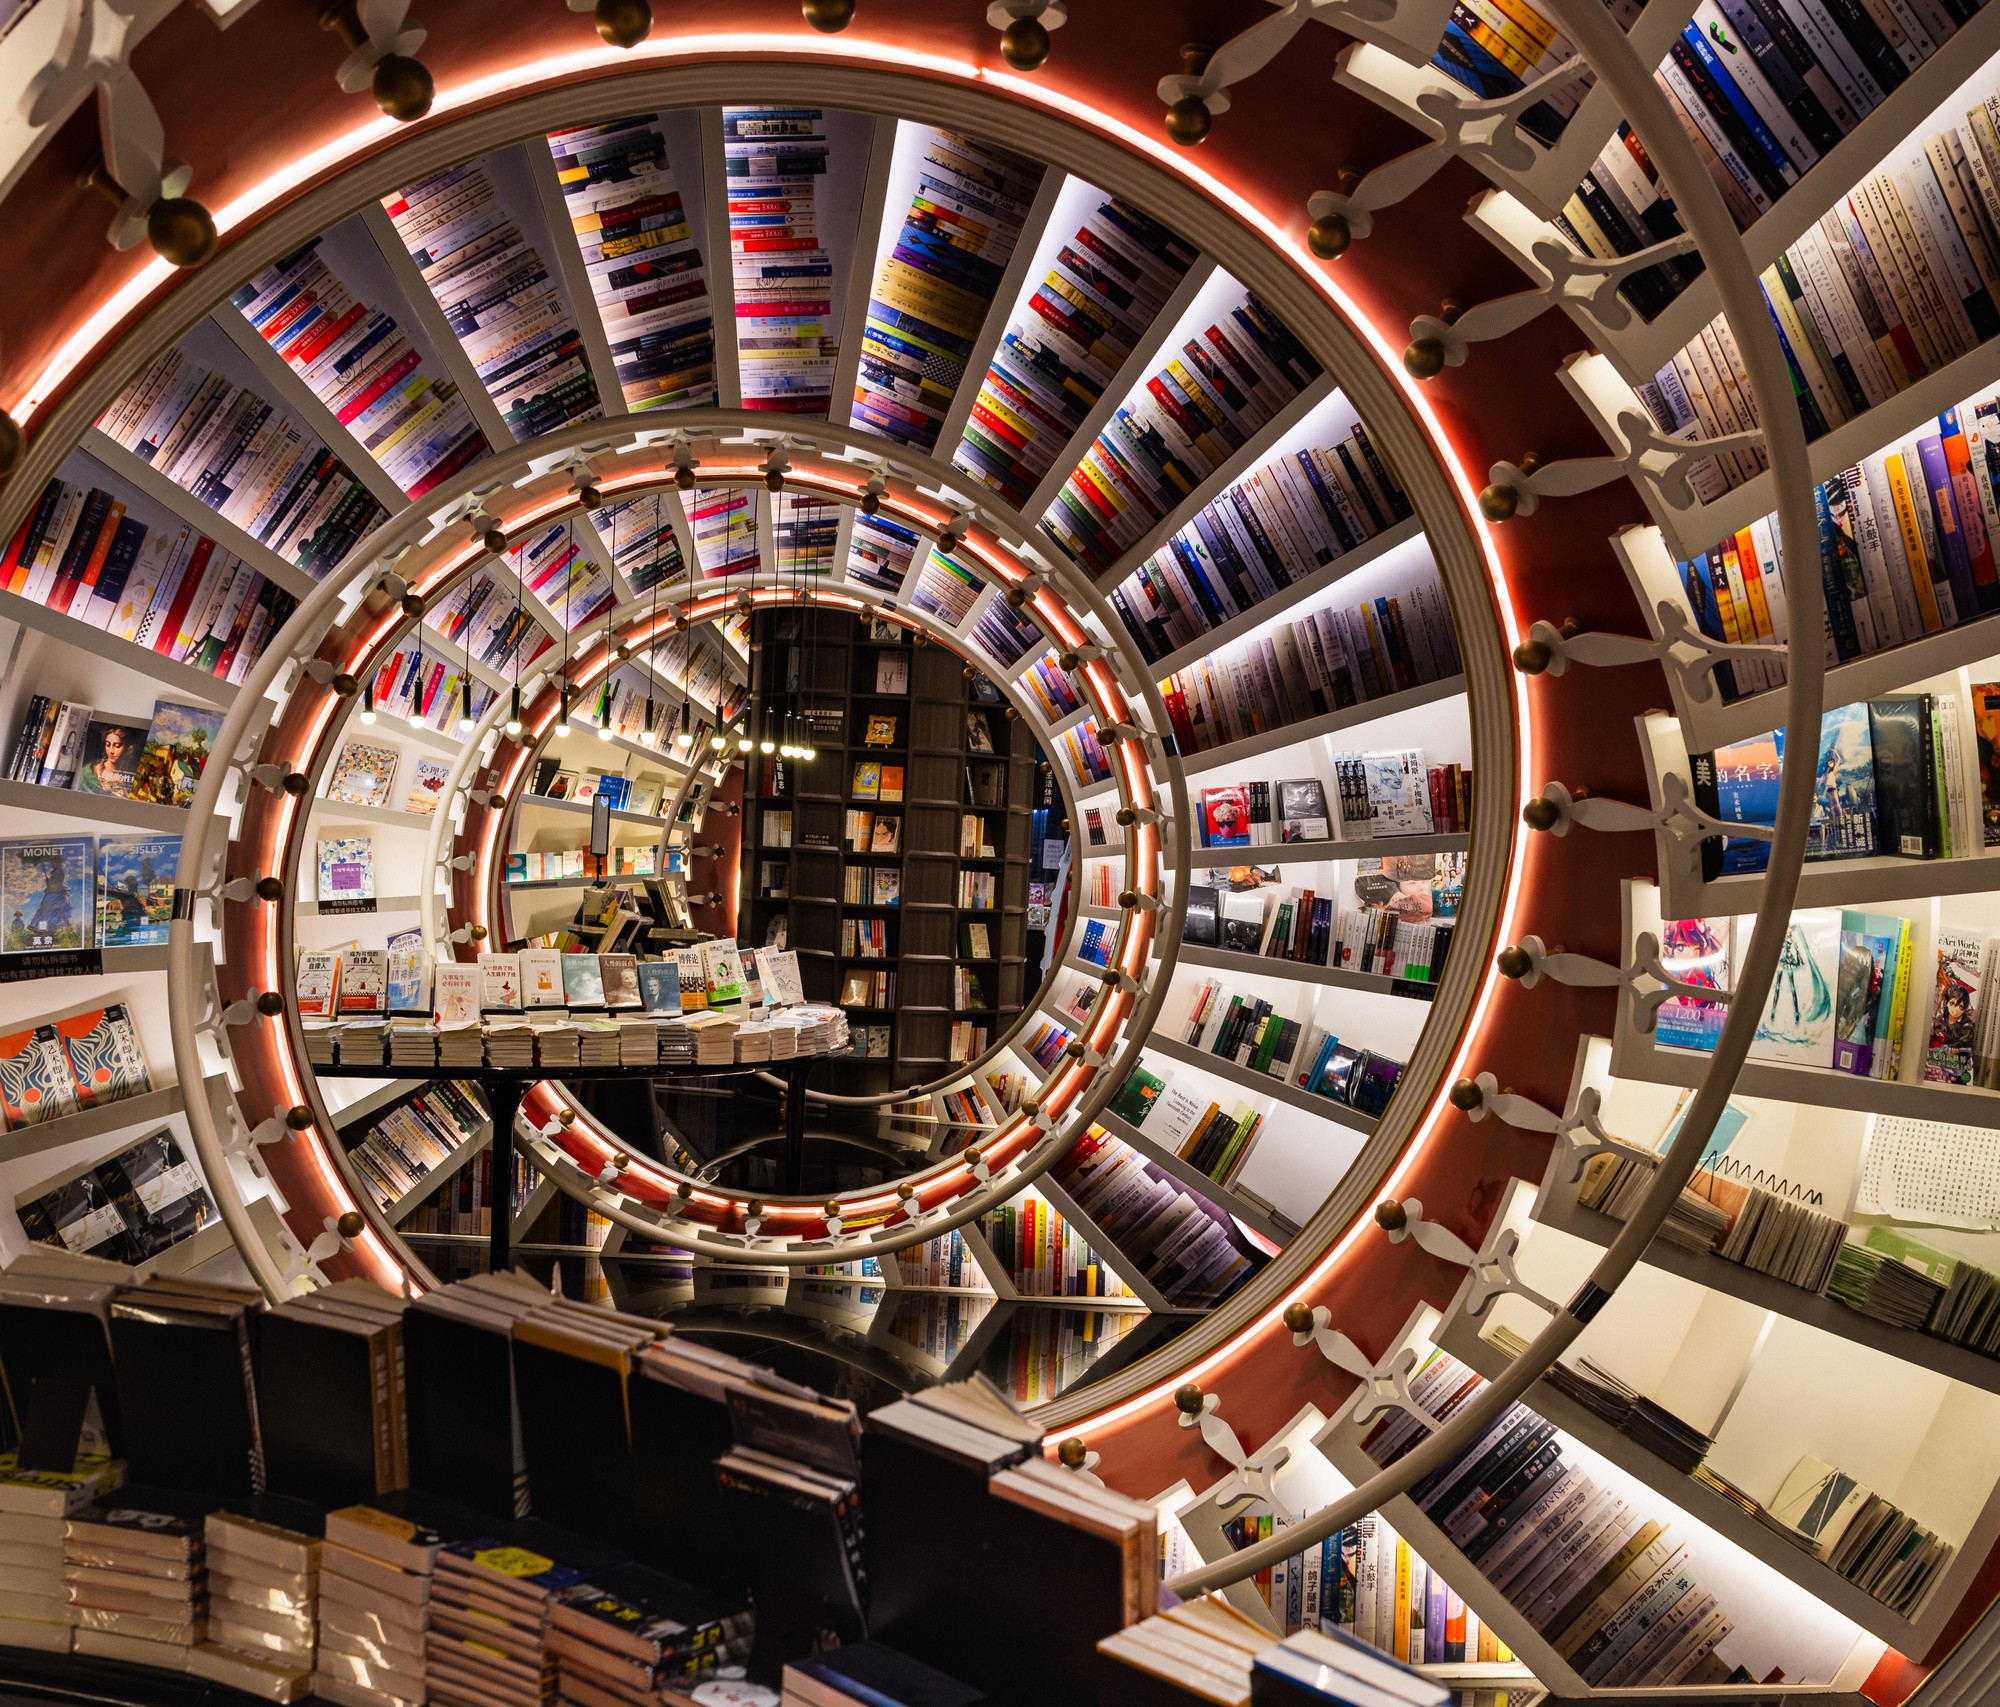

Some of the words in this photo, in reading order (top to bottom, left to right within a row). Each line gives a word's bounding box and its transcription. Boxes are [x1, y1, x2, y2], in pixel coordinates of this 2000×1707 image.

[1664, 374, 1691, 419] SEELENBUCH
[1981, 474, 1996, 515] 夜莺与玫瑰
[1895, 479, 1918, 552] 天空下的两万条街道
[1863, 517, 1881, 552] 女鼓手
[1853, 813, 1867, 848] 新海诚
[23, 847, 65, 857] MONET
[129, 845, 165, 855] SISLEY
[32, 936, 53, 946] 莫奈
[1944, 937, 1957, 946] Art
[1957, 938, 1981, 950] Works
[1, 966, 101, 980] 如有需要请寻找工作人员
[22, 954, 78, 965] 请勿私拆图书
[646, 968, 675, 976] 人性的优点
[678, 954, 699, 965] 博弈论
[1675, 1008, 1701, 1021] 1200
[117, 1023, 139, 1077] 艺术即体验
[47, 1043, 69, 1097] 艺术即体验
[1532, 1476, 1575, 1517] 工艺之道
[1366, 1564, 1377, 1591] 女鼓手
[1306, 1570, 1318, 1613] 鸽子隧道
